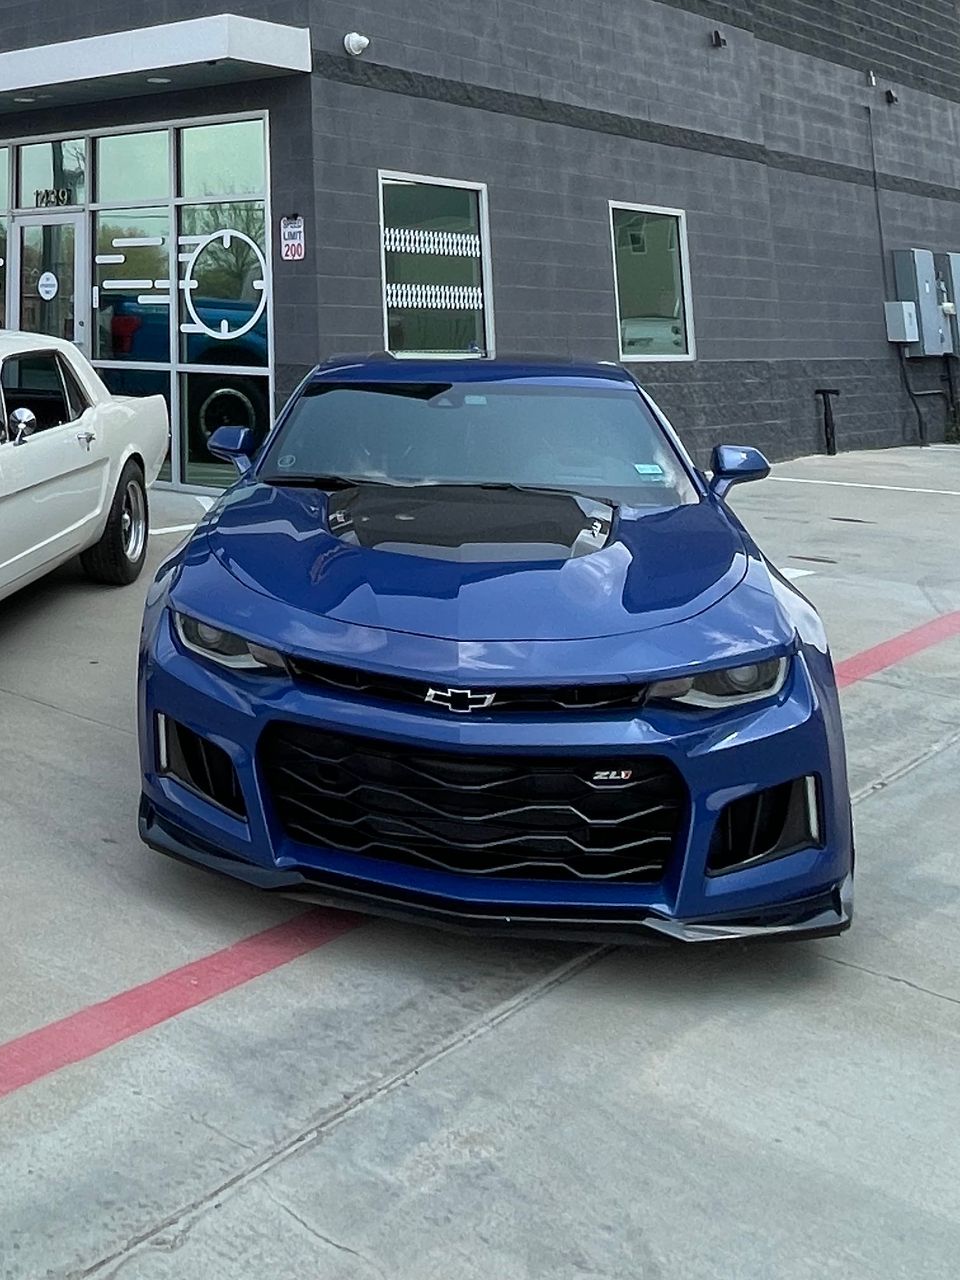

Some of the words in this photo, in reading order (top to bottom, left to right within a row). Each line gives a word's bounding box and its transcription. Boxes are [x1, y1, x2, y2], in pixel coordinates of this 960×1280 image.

[283, 231, 302, 241] LIMIT
[285, 243, 303, 258] 200
[592, 770, 632, 780] ZL1
